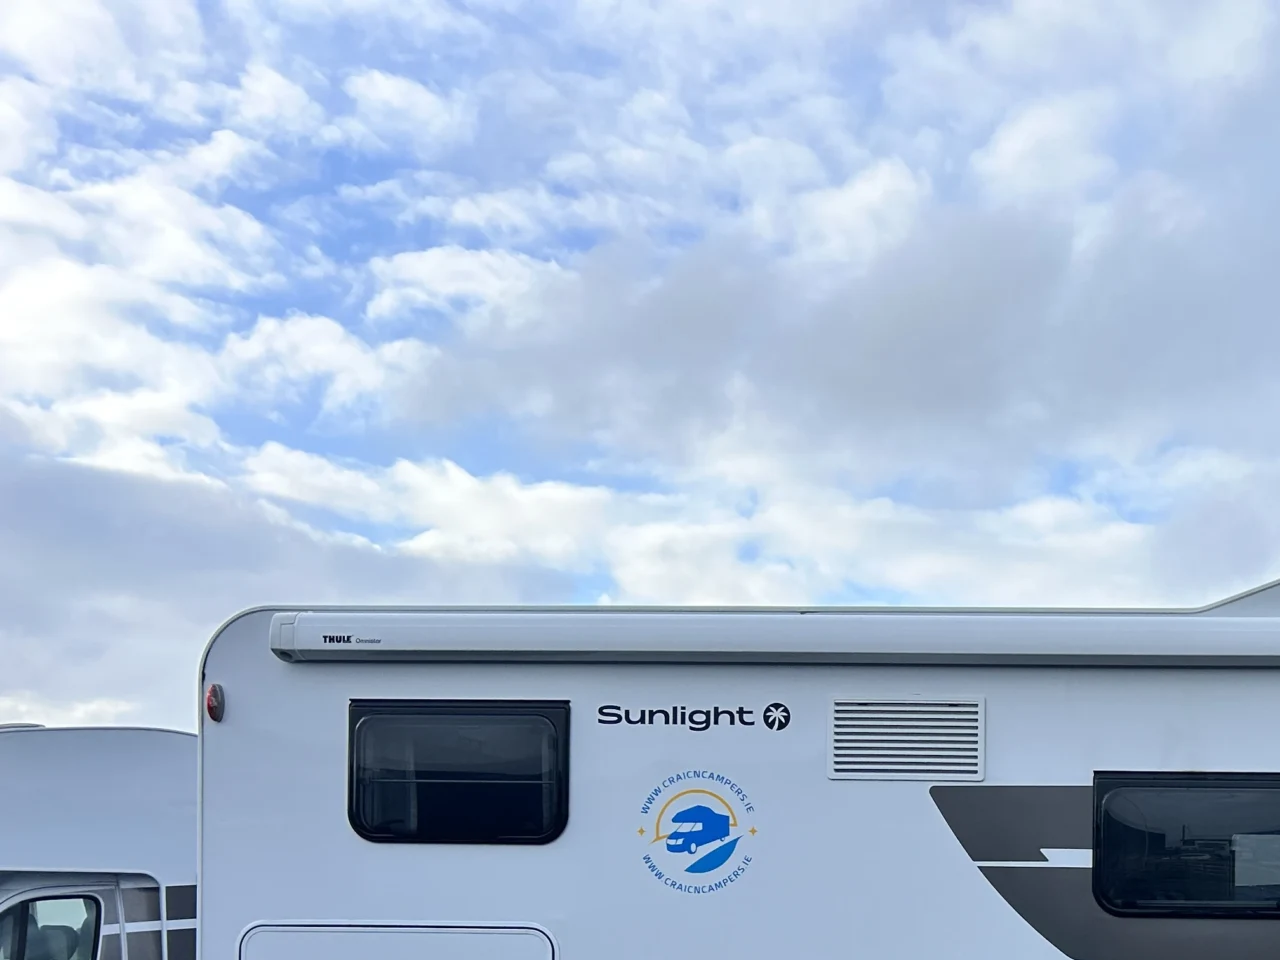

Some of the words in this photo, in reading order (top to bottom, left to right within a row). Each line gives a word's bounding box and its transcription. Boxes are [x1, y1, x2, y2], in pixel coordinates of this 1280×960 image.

[322, 635, 352, 644] THULE
[597, 704, 756, 732] Sunlight
[640, 770, 755, 815] WWW.CRAICNCAMPERS.IE
[642, 853, 753, 895] WWW.CRAICNCAMPERS.IE
